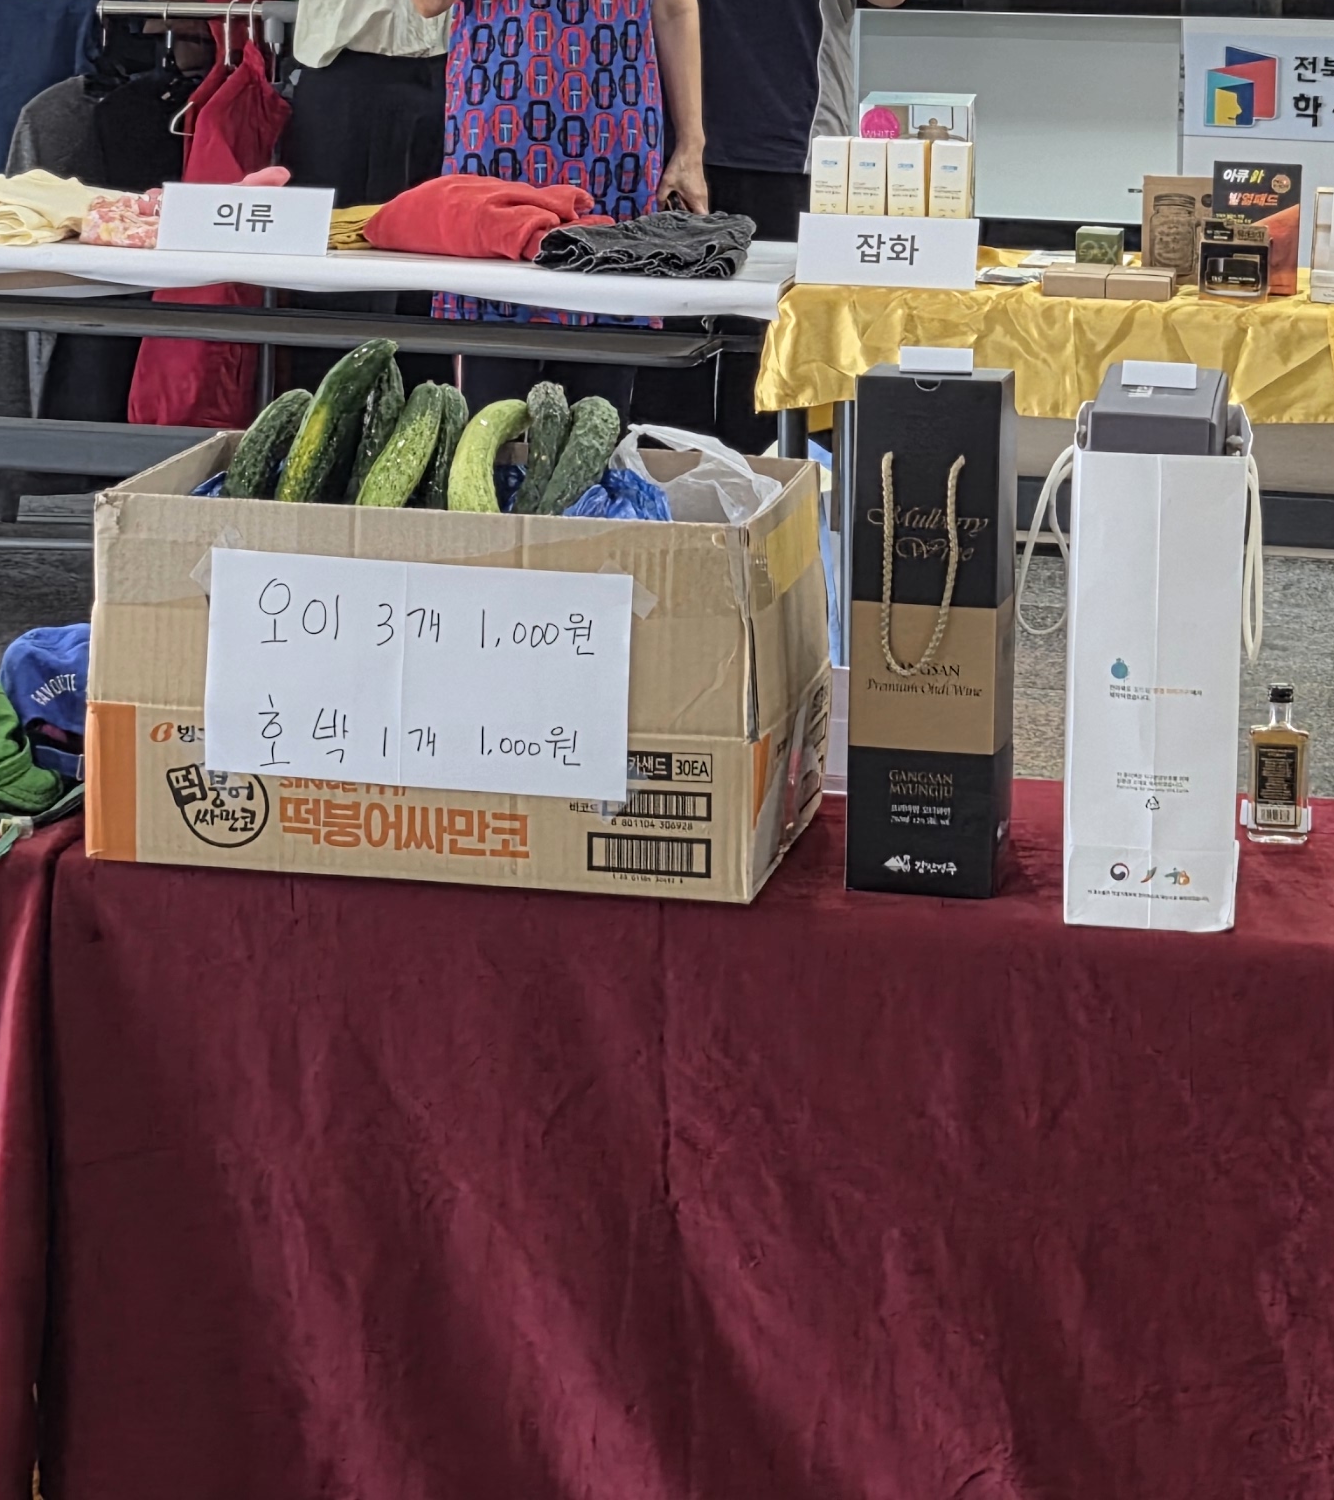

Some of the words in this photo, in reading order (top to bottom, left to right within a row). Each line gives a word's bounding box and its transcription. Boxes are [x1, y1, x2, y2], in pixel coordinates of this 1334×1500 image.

[213, 202, 274, 233] 의류
[855, 233, 920, 266] 잡화
[258, 578, 341, 644] 오이
[376, 602, 442, 647] 3개
[481, 608, 595, 656] 1,000원
[258, 693, 350, 767] 호박
[382, 726, 436, 757] 1개
[675, 759, 709, 777] 30EA
[888, 769, 953, 785] GANGSAN
[889, 783, 954, 800] MYUNGJU
[194, 806, 256, 833] 싸만코
[279, 796, 530, 859] 떡붕어싸만코
